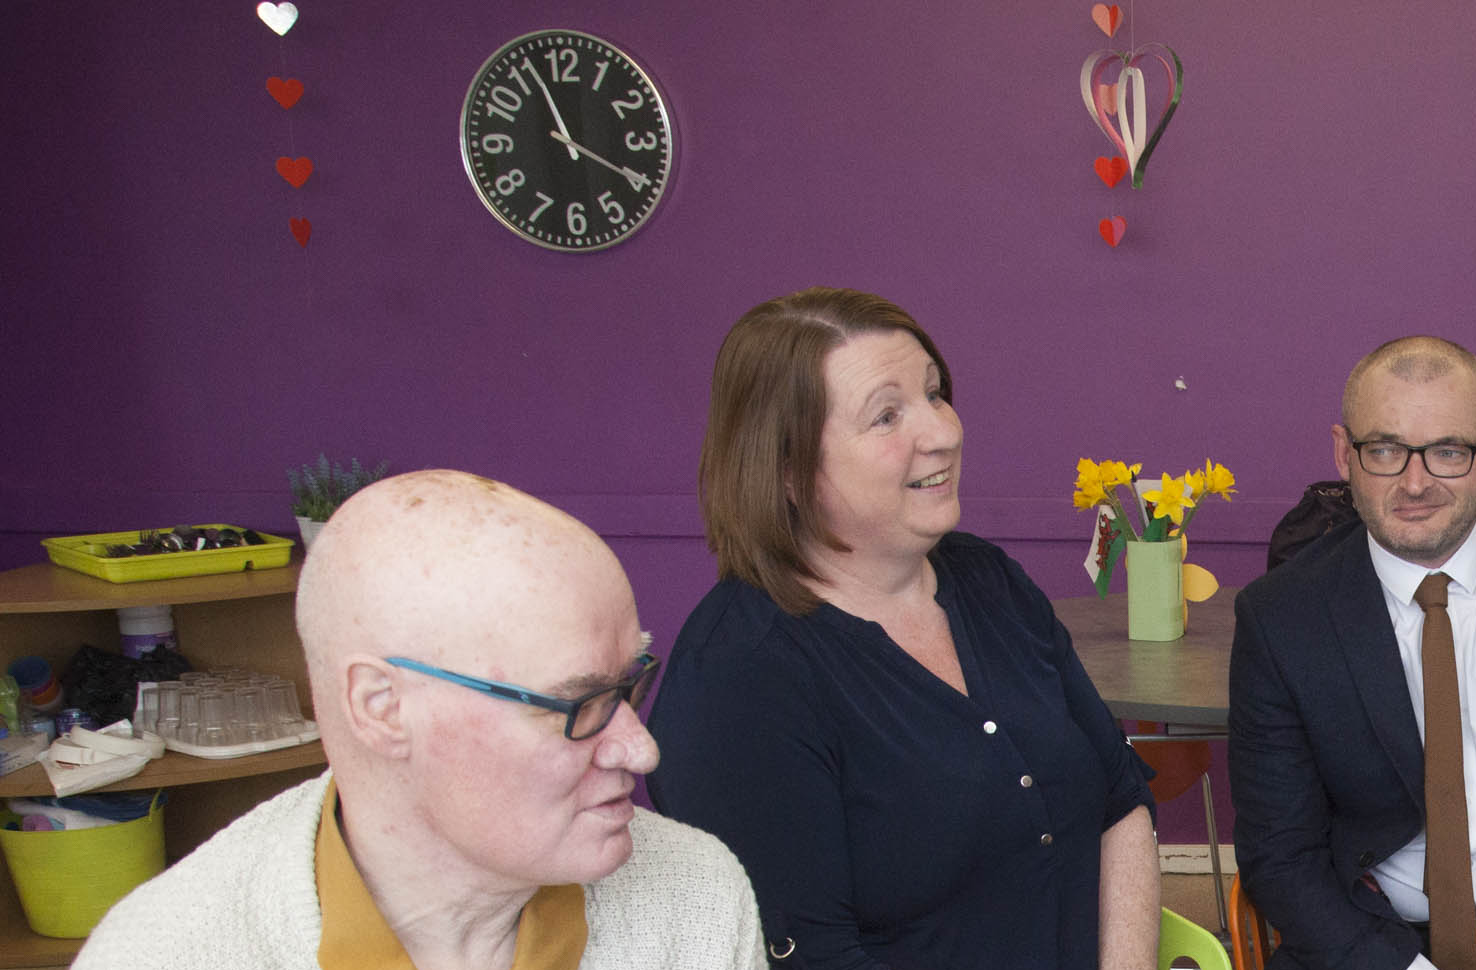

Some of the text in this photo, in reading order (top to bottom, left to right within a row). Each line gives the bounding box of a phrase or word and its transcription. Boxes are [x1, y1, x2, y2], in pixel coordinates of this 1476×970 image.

[507, 56, 545, 95] 11
[544, 49, 581, 83] 12
[592, 61, 610, 92] 1
[485, 85, 523, 123] 10
[611, 89, 644, 120] 2
[482, 133, 514, 154] 9
[625, 131, 658, 152] 3
[495, 168, 526, 196] 8
[622, 166, 652, 193] 4
[528, 191, 554, 223] 7
[566, 202, 588, 236] 6
[597, 190, 625, 225] 5
